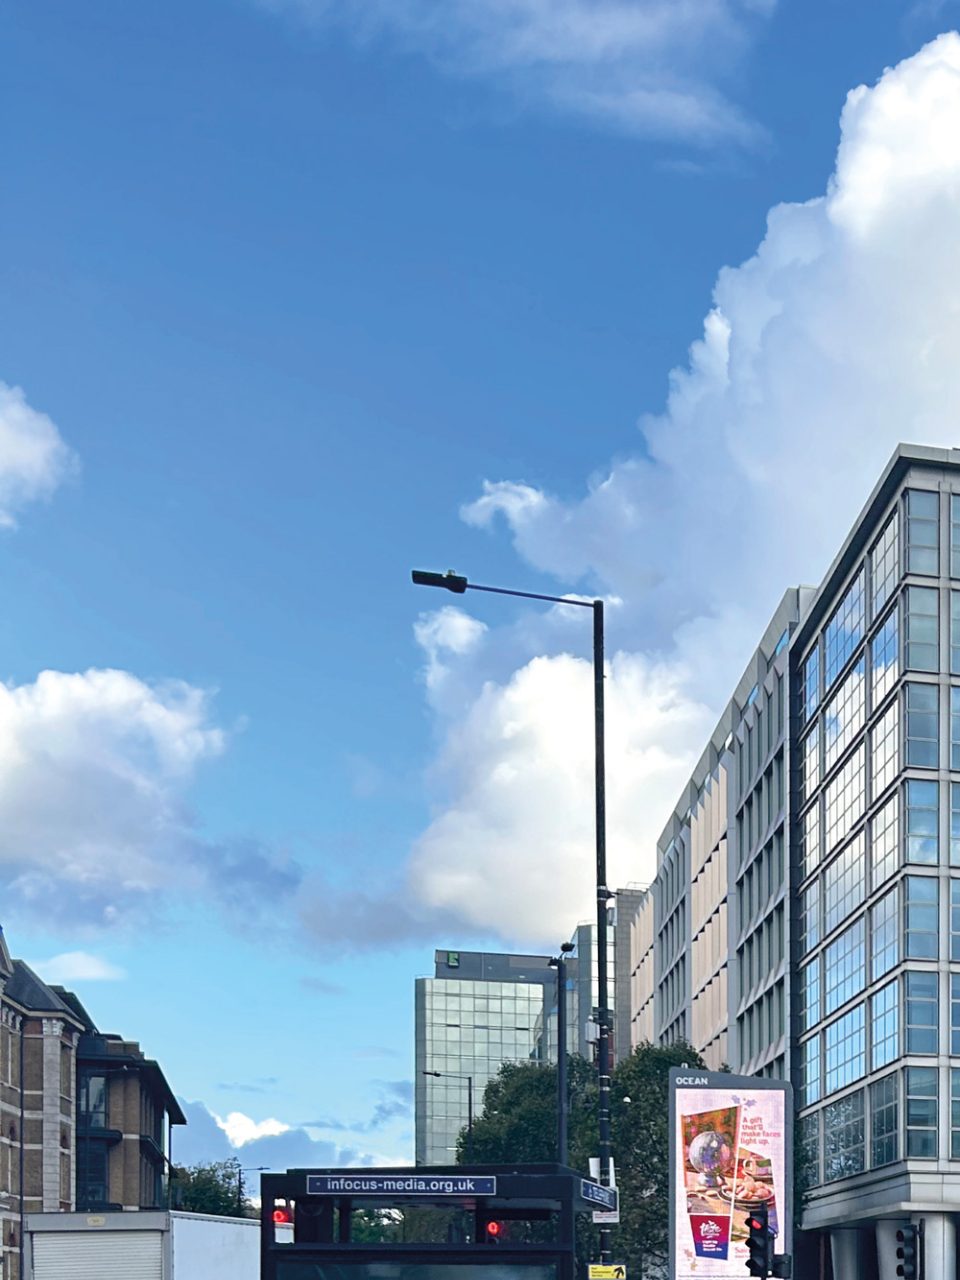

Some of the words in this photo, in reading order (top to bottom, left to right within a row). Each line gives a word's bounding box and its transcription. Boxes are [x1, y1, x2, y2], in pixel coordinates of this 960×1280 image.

[675, 1077, 708, 1085] OCEAN
[750, 1117, 763, 1125] gift
[762, 1130, 781, 1138] faces
[326, 1177, 475, 1193] infocus-media.org.uk
